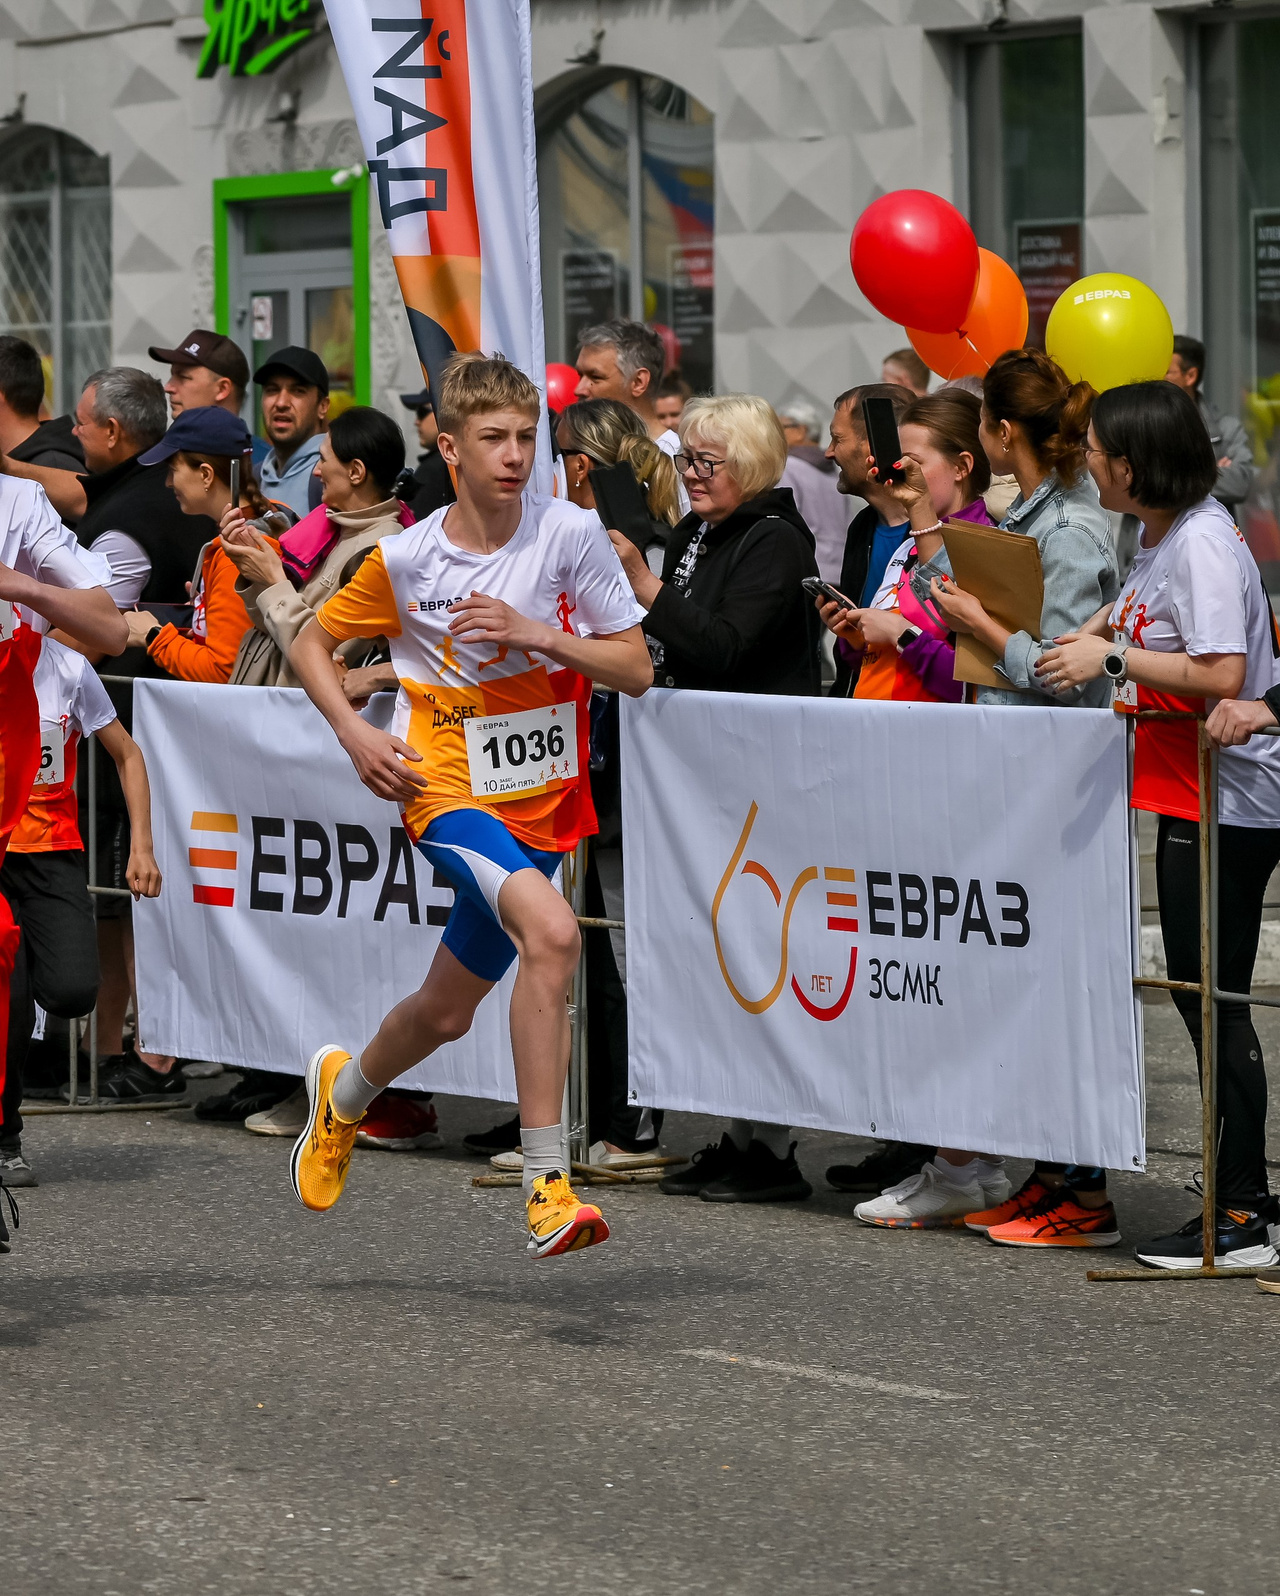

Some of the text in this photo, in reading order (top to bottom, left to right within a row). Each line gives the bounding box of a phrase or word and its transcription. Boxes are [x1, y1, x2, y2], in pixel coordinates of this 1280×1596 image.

[367, 18, 451, 229] ДАЙ
[1085, 290, 1131, 301] ЕВРАЗ
[483, 721, 509, 730] ЕВРАЗ
[482, 725, 565, 769] 1036
[484, 780, 498, 793] 10
[499, 780, 536, 792] ДАЙ ПЯТЬ
[866, 870, 1031, 948] ЕВРАЗ
[811, 974, 833, 993] ЛЕТ
[868, 957, 944, 1006] ЗСМК
